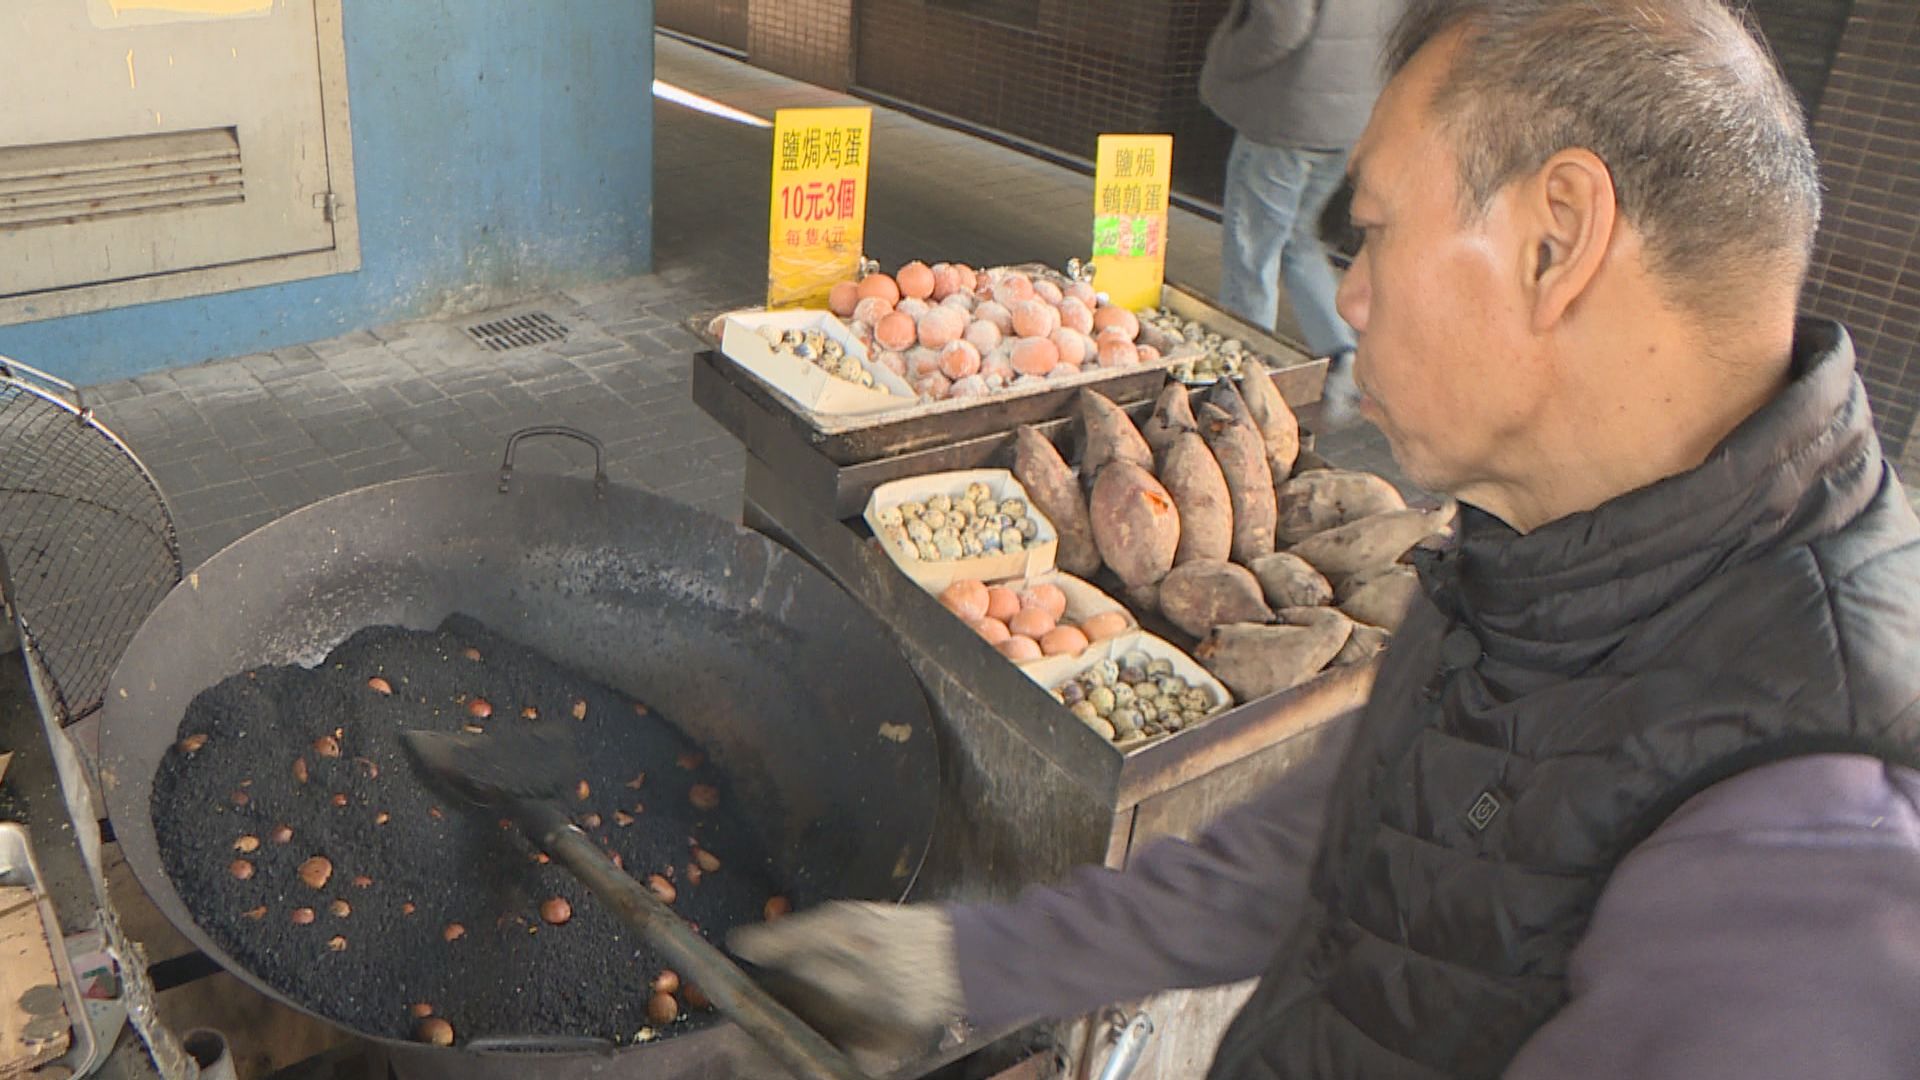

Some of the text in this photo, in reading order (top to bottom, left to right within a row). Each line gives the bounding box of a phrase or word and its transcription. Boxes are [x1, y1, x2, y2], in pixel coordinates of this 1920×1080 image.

[782, 128, 862, 170] 鹽焗鸡蛋
[782, 178, 856, 221] 10元3個
